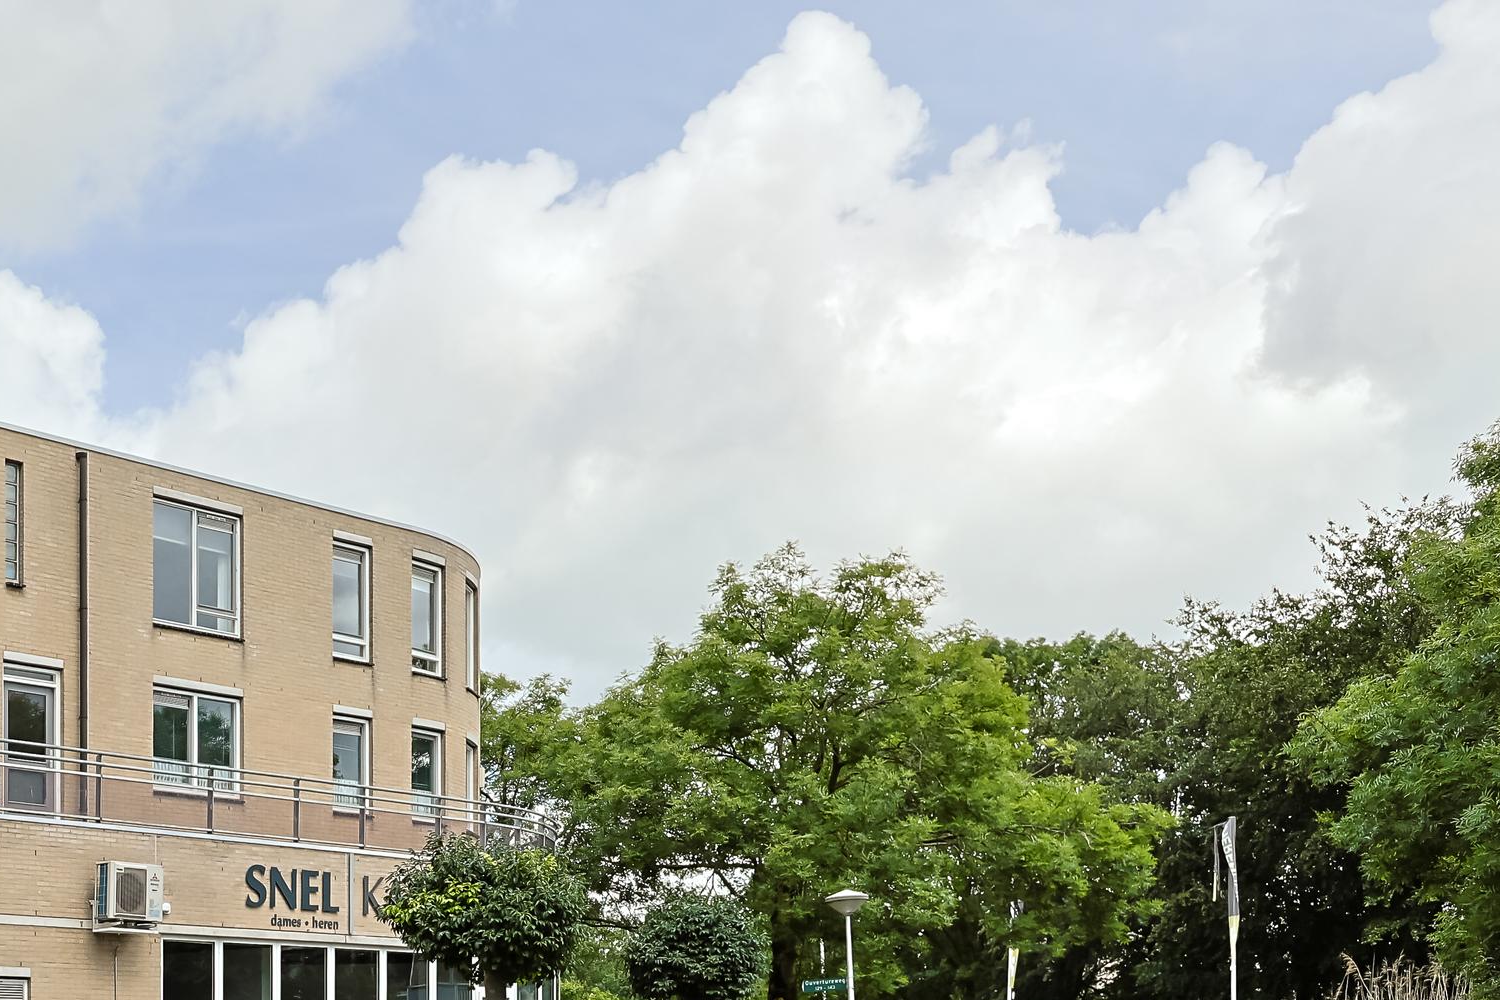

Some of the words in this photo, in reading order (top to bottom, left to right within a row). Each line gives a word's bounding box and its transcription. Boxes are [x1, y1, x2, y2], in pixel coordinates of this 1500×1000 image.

[245, 864, 340, 914] SNEL
[270, 914, 301, 928] dames
[311, 916, 339, 930] heren
